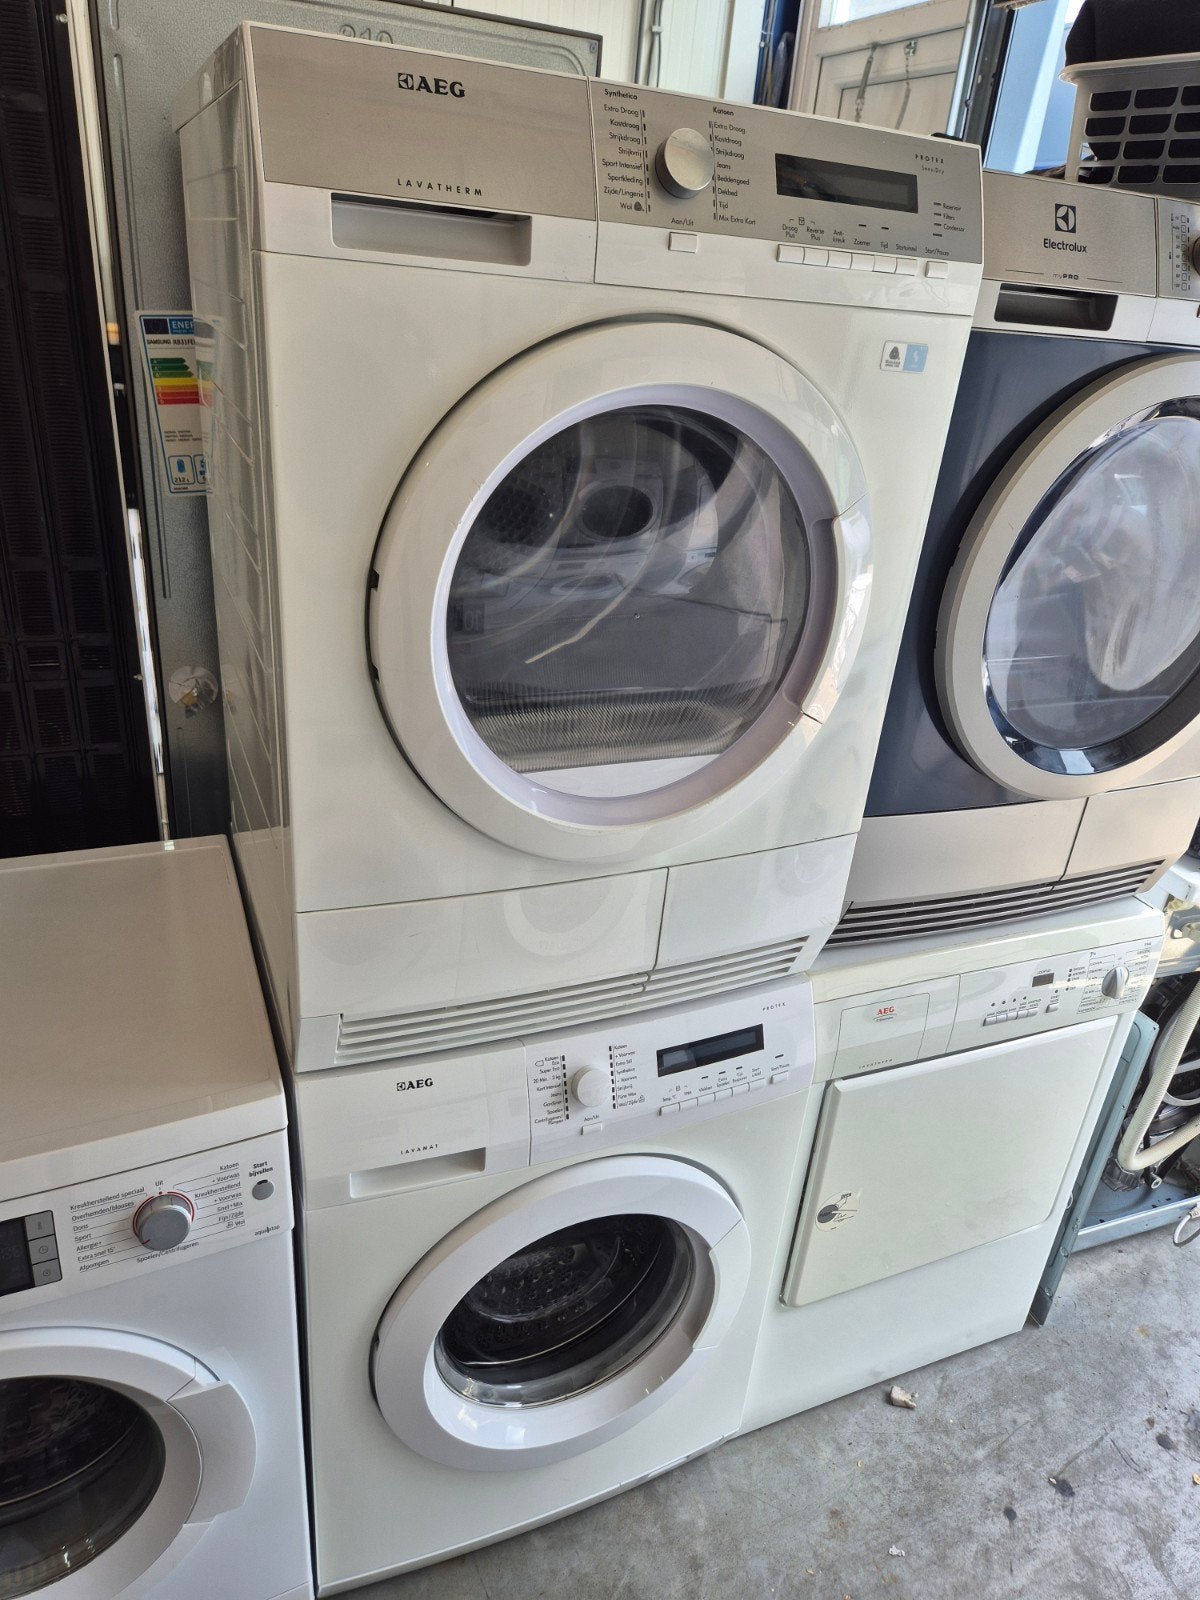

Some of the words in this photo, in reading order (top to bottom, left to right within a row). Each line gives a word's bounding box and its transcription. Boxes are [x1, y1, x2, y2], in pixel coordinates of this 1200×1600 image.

[416, 75, 466, 98] AEG
[603, 103, 619, 113] Extra
[620, 106, 639, 118] Droog
[610, 118, 640, 131] Kastdroog
[713, 121, 728, 130] Extra
[729, 124, 746, 135] Droog
[609, 131, 641, 145] Strijkdroog
[715, 134, 742, 147] Kastdroog
[715, 147, 745, 161] Strijkdroog
[602, 158, 618, 168] Sport
[619, 161, 643, 171] Intensief
[607, 172, 644, 186] Sportkleding
[717, 174, 750, 186] Beddengoed
[396, 177, 483, 197] LAVATHERM
[603, 185, 644, 199] Zijde/Lingerie
[717, 187, 738, 197] Dekbed
[619, 202, 633, 210] Wol
[718, 201, 729, 210] Tijd
[718, 214, 729, 222] Mix
[730, 215, 744, 224] Extra
[744, 217, 756, 226] Kort
[782, 223, 799, 234] Droog
[806, 225, 825, 235] Reverse
[785, 231, 796, 239] Plus
[810, 233, 821, 241] Plus
[853, 238, 871, 247] Zoemer
[880, 241, 889, 250] Tijd
[1043, 237, 1088, 253] Electrolux
[1052, 273, 1079, 281] myPRO
[762, 1002, 787, 1012] PROTEX
[875, 1006, 895, 1016] AEG
[406, 1077, 434, 1091] AEG
[400, 1143, 439, 1155] LAVAMAT
[219, 1162, 240, 1171] Katoen
[252, 1161, 268, 1169] Start
[216, 1172, 240, 1182] Voorwas
[248, 1166, 274, 1178] bijvullen
[194, 1181, 241, 1199] Kreukherstellend
[70, 1193, 120, 1211] Kreukherstellend
[121, 1187, 145, 1199] speciaal
[218, 1192, 242, 1202] Voorwas
[71, 1201, 135, 1222] Overhemden/blouses
[73, 1224, 89, 1232] Dons
[74, 1233, 92, 1243] Sport
[76, 1241, 102, 1252] Allergie+
[77, 1253, 94, 1262] Extra
[94, 1249, 107, 1258] snel
[79, 1259, 110, 1272] Afpompen
